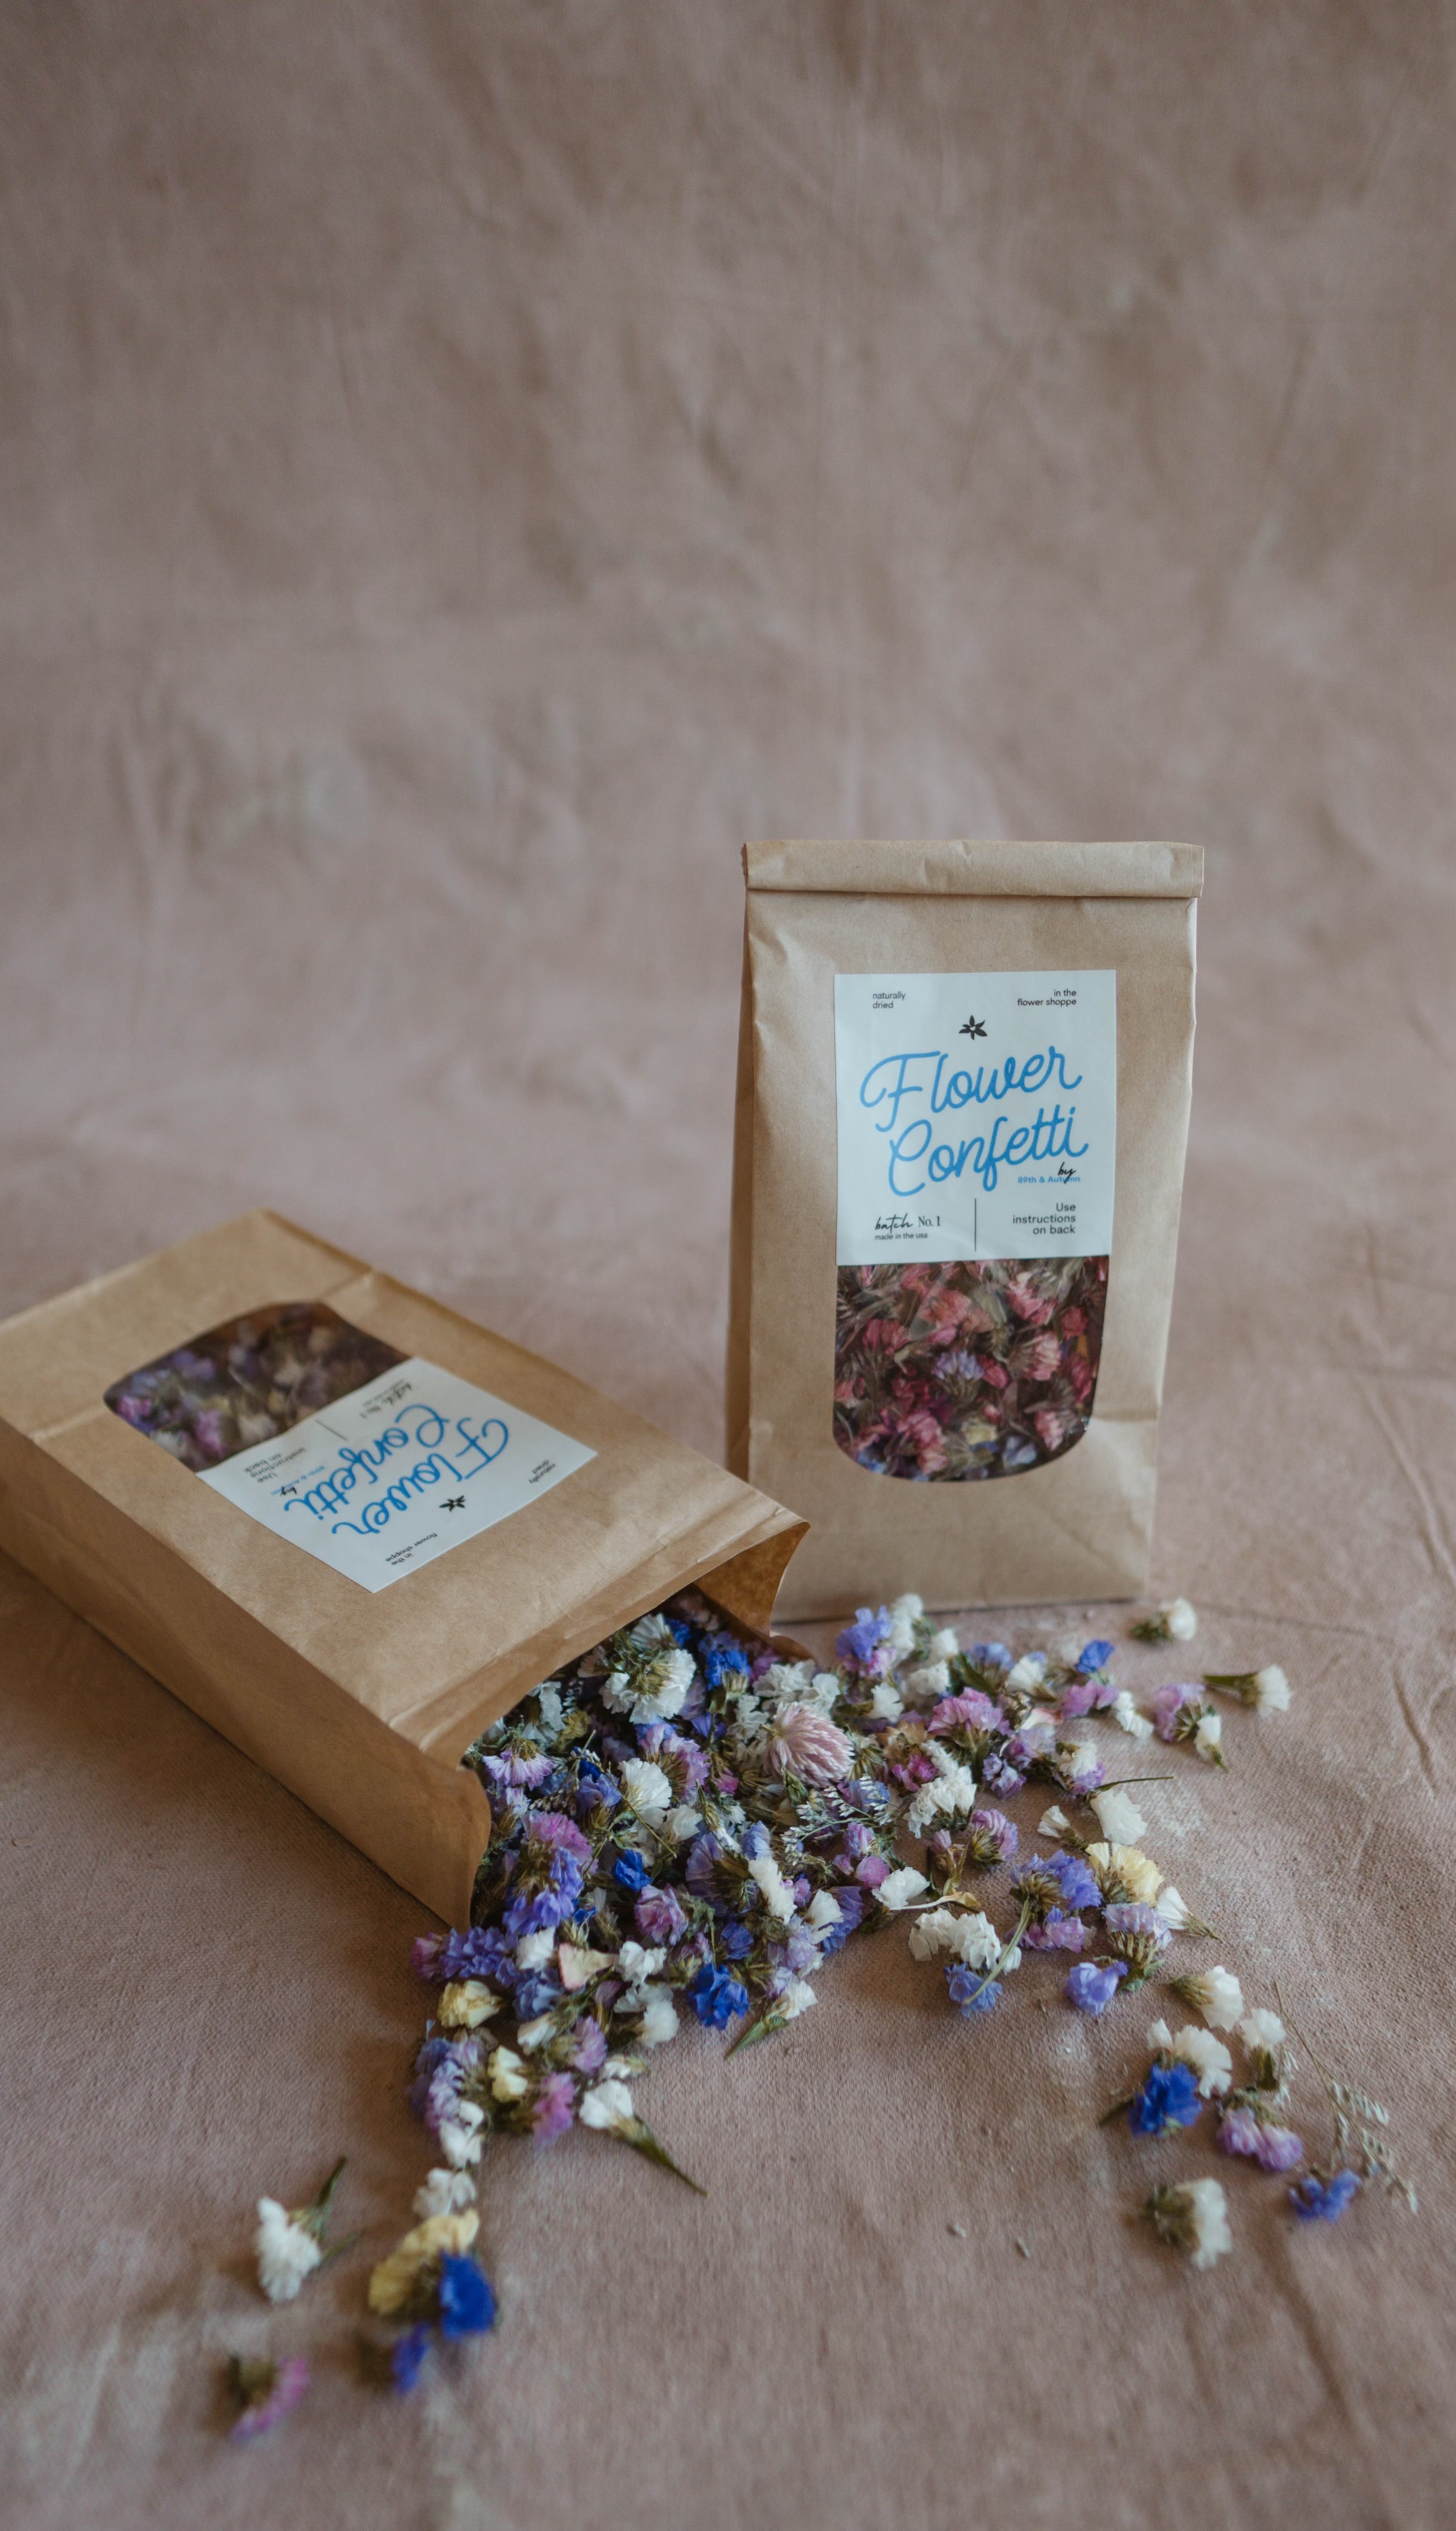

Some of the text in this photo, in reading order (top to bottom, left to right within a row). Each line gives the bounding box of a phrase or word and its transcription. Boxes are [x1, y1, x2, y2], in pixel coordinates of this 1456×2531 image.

[872, 990, 906, 1001] naturally
[1054, 989, 1077, 997] in the
[872, 1001, 894, 1009] dried
[1017, 997, 1077, 1007] flower shoppe
[859, 1045, 1083, 1133] Flower
[887, 1104, 1090, 1197] Confetti
[1057, 1161, 1077, 1185] by
[1055, 1202, 1076, 1212] Use
[874, 1212, 941, 1233] batch No. 1
[1012, 1213, 1076, 1224] instructions
[1049, 1223, 1076, 1234] back
[283, 1403, 451, 1521] Confetti
[332, 1417, 510, 1535] Flower
[385, 1532, 438, 1562] flower shoppe
